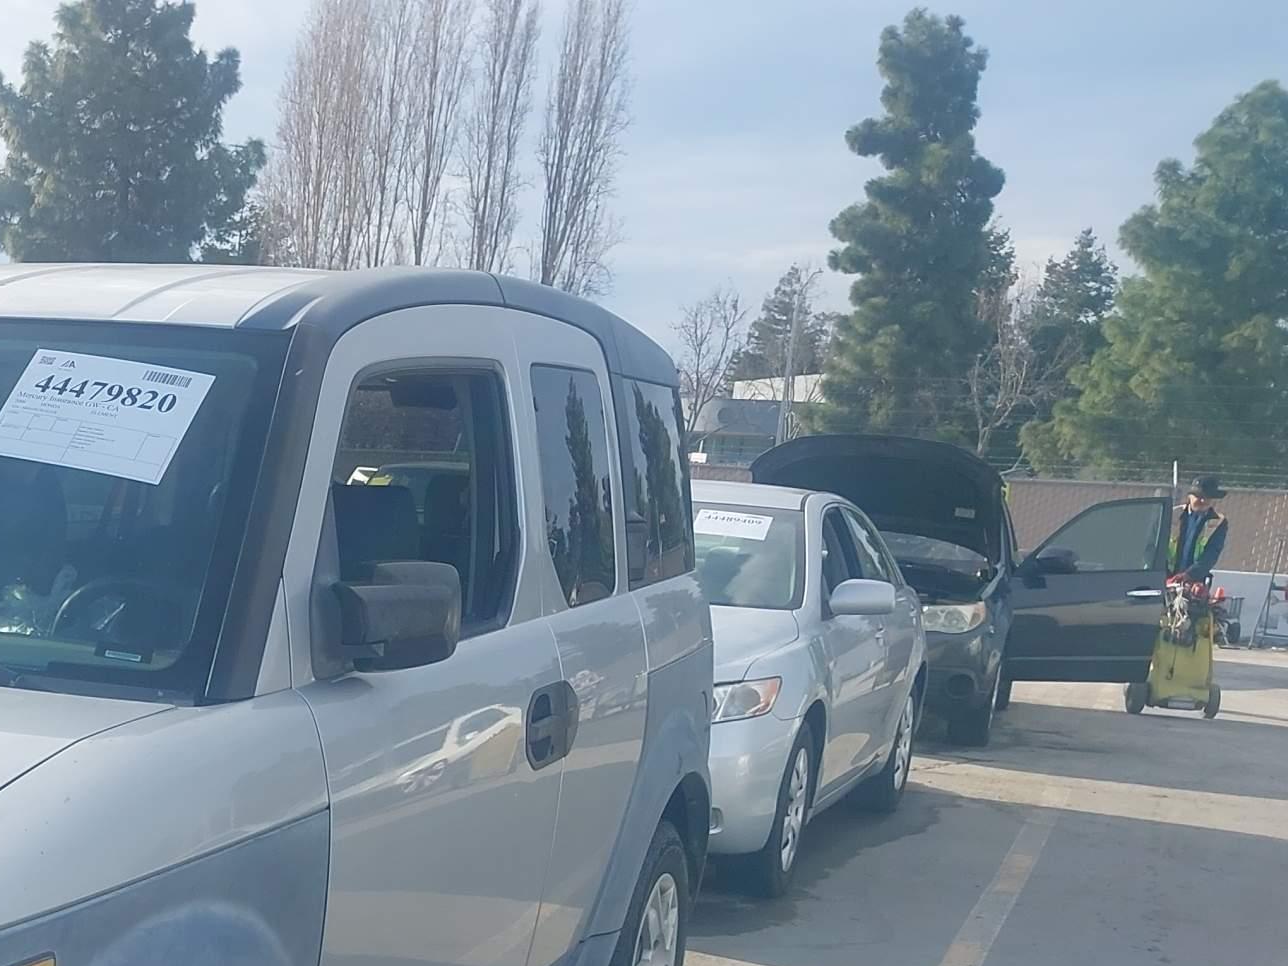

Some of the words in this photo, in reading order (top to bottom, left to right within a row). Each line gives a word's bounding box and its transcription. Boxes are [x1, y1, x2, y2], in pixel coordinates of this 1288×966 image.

[18, 391, 47, 402] Mercury
[49, 394, 84, 407] Insurance
[107, 404, 120, 412] CA
[34, 374, 178, 413] 44479820
